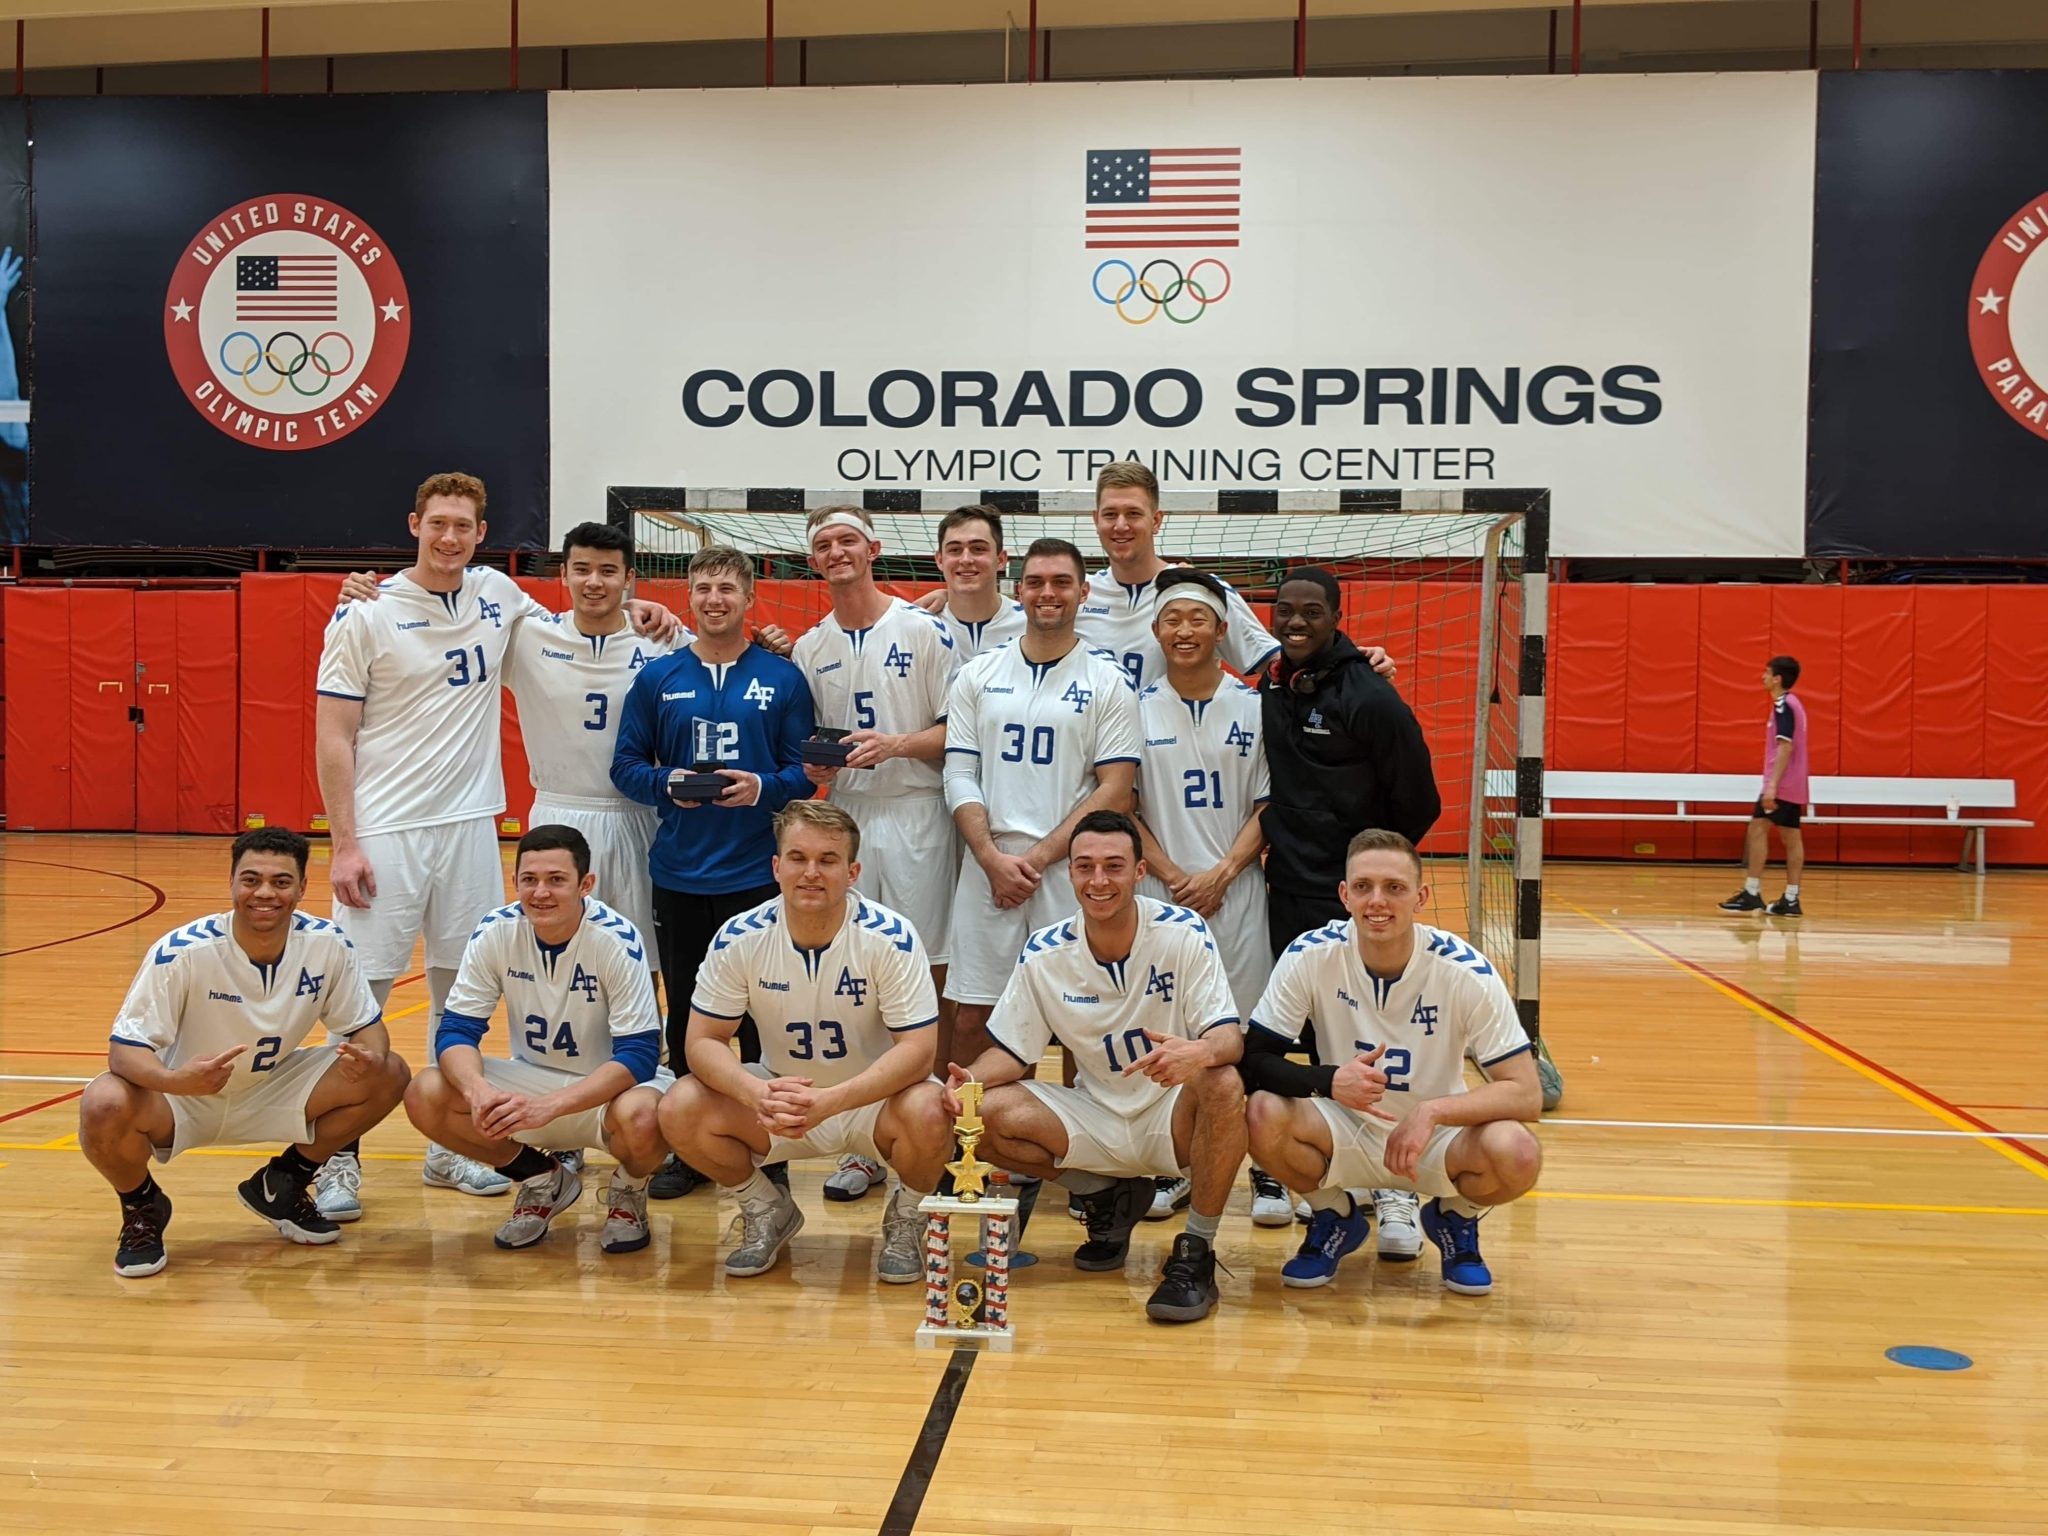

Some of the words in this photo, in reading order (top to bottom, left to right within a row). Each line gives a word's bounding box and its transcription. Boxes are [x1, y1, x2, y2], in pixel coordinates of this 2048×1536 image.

[192, 203, 279, 266] UNITED
[294, 203, 382, 267] STATES
[194, 380, 298, 442] OLYMPIC
[314, 382, 378, 437] TEAM
[682, 368, 1202, 428] COLORADO
[1235, 365, 1662, 428] SPRINGS
[1988, 357, 2048, 430] PARA
[837, 448, 1041, 481] OLYMPIC
[1299, 447, 1494, 481] CENTER
[396, 619, 430, 630] hummel
[478, 596, 501, 627] AF
[1082, 605, 1110, 615] hummel
[445, 645, 487, 686] 31
[541, 648, 575, 661] hummel
[628, 647, 657, 669] A
[816, 659, 842, 675] hummel
[884, 642, 912, 677] AF
[662, 690, 695, 702] hummel
[743, 677, 774, 710] AF
[984, 685, 1014, 695] hummel
[1061, 681, 1092, 713] AF
[584, 693, 608, 730] 3
[854, 691, 875, 729] 5
[696, 722, 739, 760] 12
[1001, 723, 1055, 765] 30
[1145, 736, 1177, 747] hummel
[1225, 721, 1253, 757] AF
[1184, 769, 1224, 808] 21
[209, 989, 243, 1003] humme
[296, 966, 324, 1003] AF
[570, 963, 598, 1002] AF
[834, 966, 867, 1006] AF
[1063, 992, 1100, 1003] hummel
[1145, 964, 1174, 1002] AF
[1410, 994, 1438, 1035] AF
[525, 1014, 579, 1057] 24
[786, 1020, 848, 1060] 33
[1103, 1028, 1153, 1072] 10
[250, 1036, 282, 1073] 2
